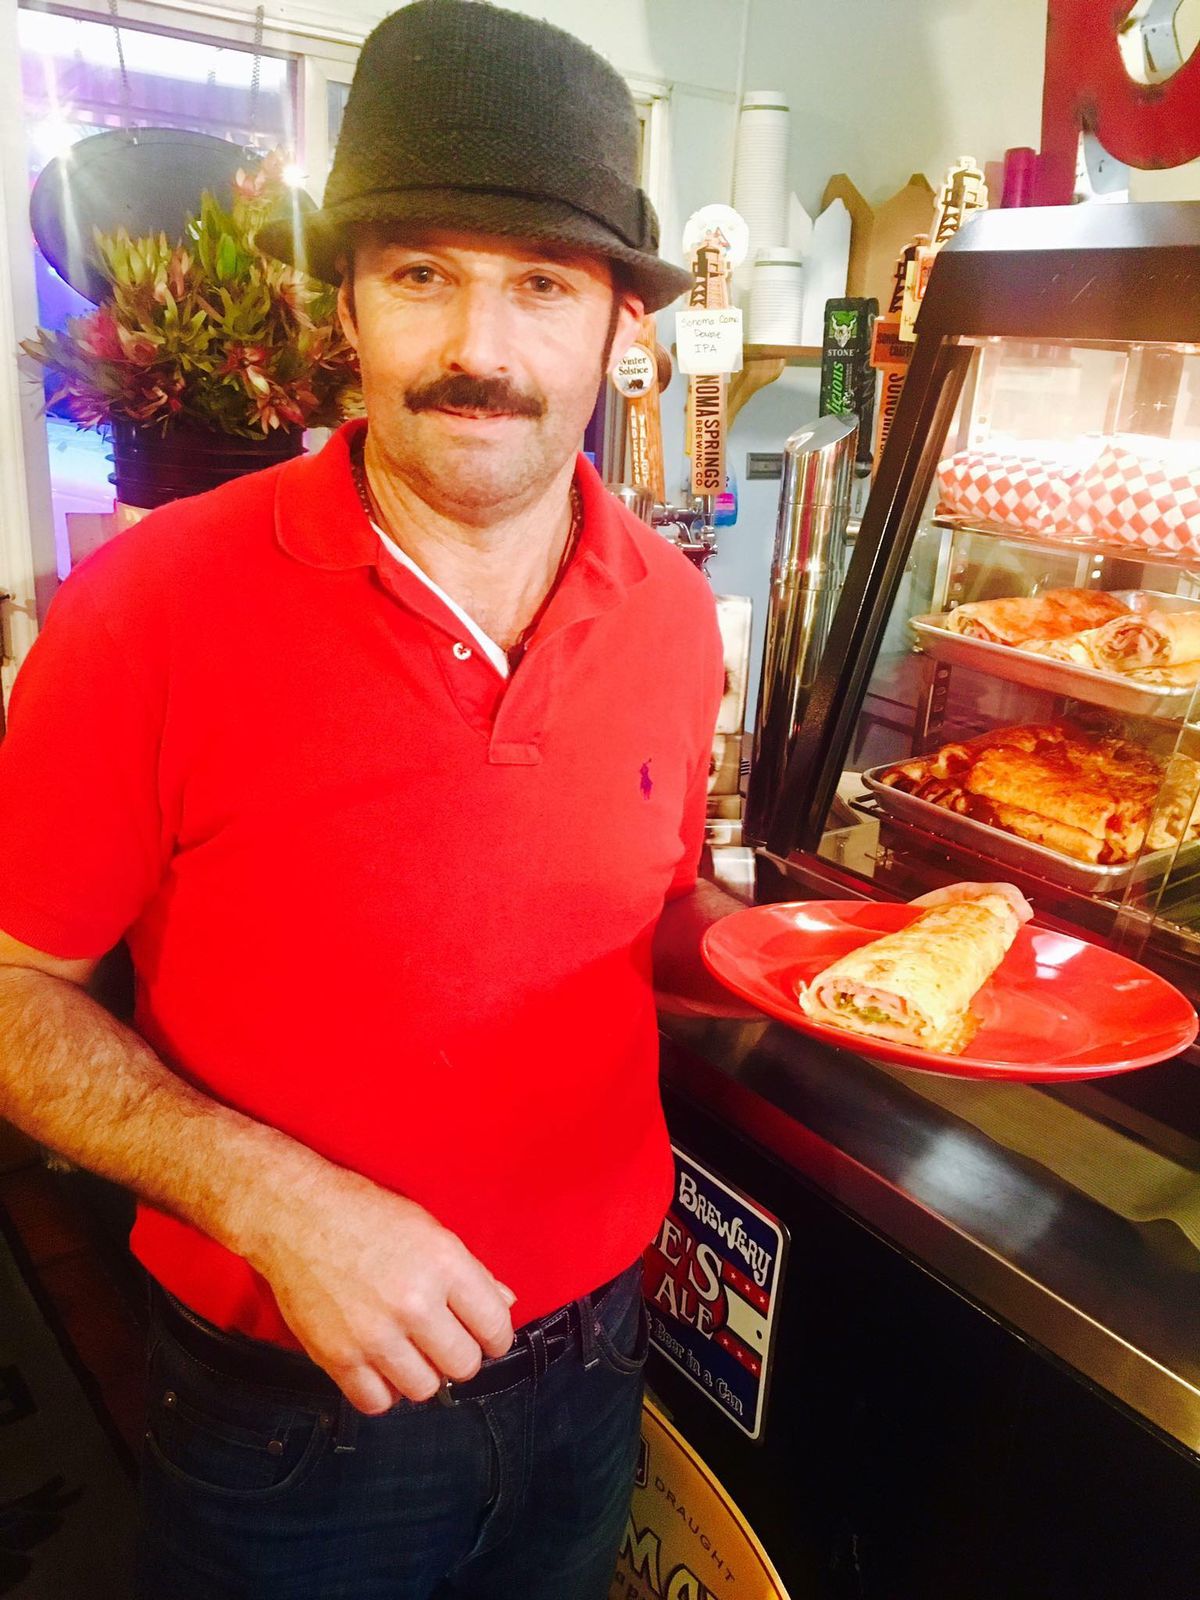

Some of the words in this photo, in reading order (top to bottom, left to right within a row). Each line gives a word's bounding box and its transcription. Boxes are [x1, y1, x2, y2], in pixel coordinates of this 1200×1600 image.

[695, 343, 717, 353] IPA
[827, 348, 855, 357] STONE
[696, 375, 720, 418] NOMA
[826, 360, 845, 414] licious
[704, 419, 720, 489] SPRINGS
[651, 1217, 722, 1301] E'S
[654, 1272, 714, 1341] ALE
[655, 1476, 736, 1583] DRAUGHT
